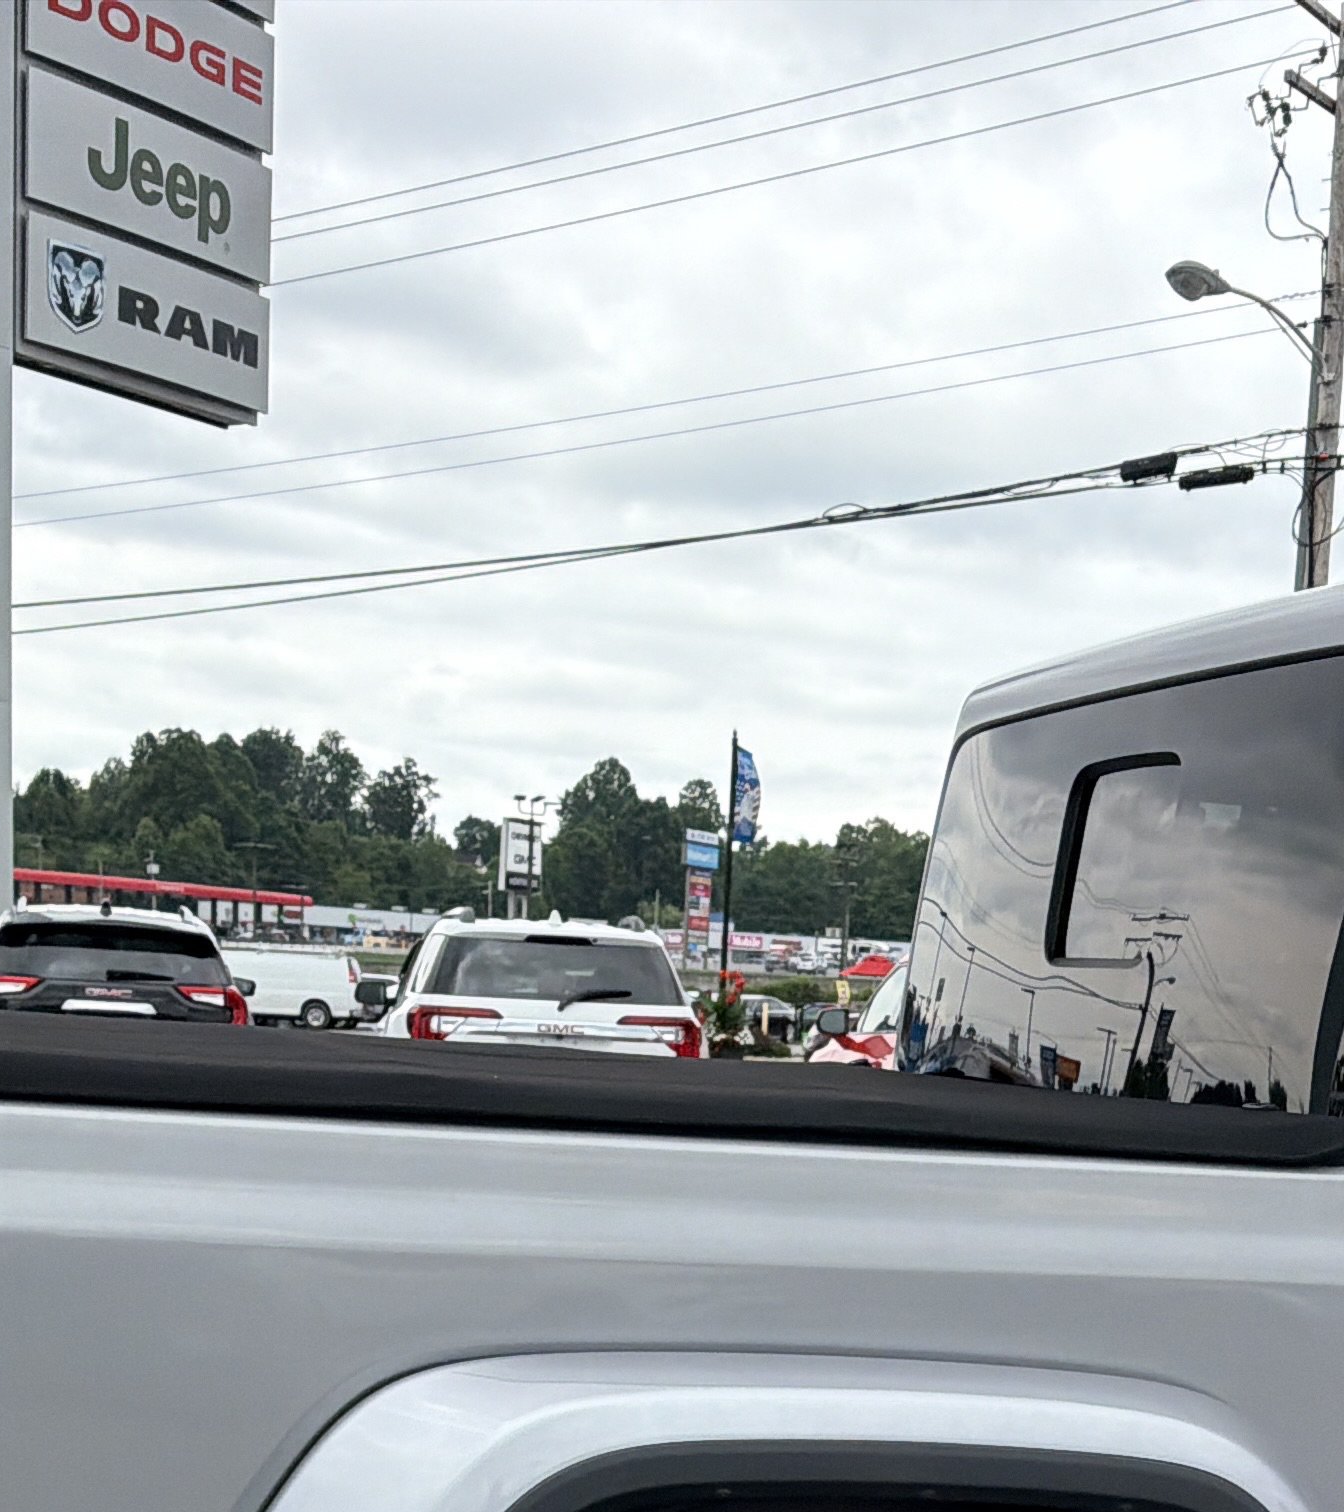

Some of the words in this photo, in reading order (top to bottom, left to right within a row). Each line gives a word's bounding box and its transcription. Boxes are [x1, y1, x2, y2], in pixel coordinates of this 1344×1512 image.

[88, 117, 231, 243] Jeep
[117, 284, 259, 369] RAM
[536, 1023, 585, 1035] GMC
